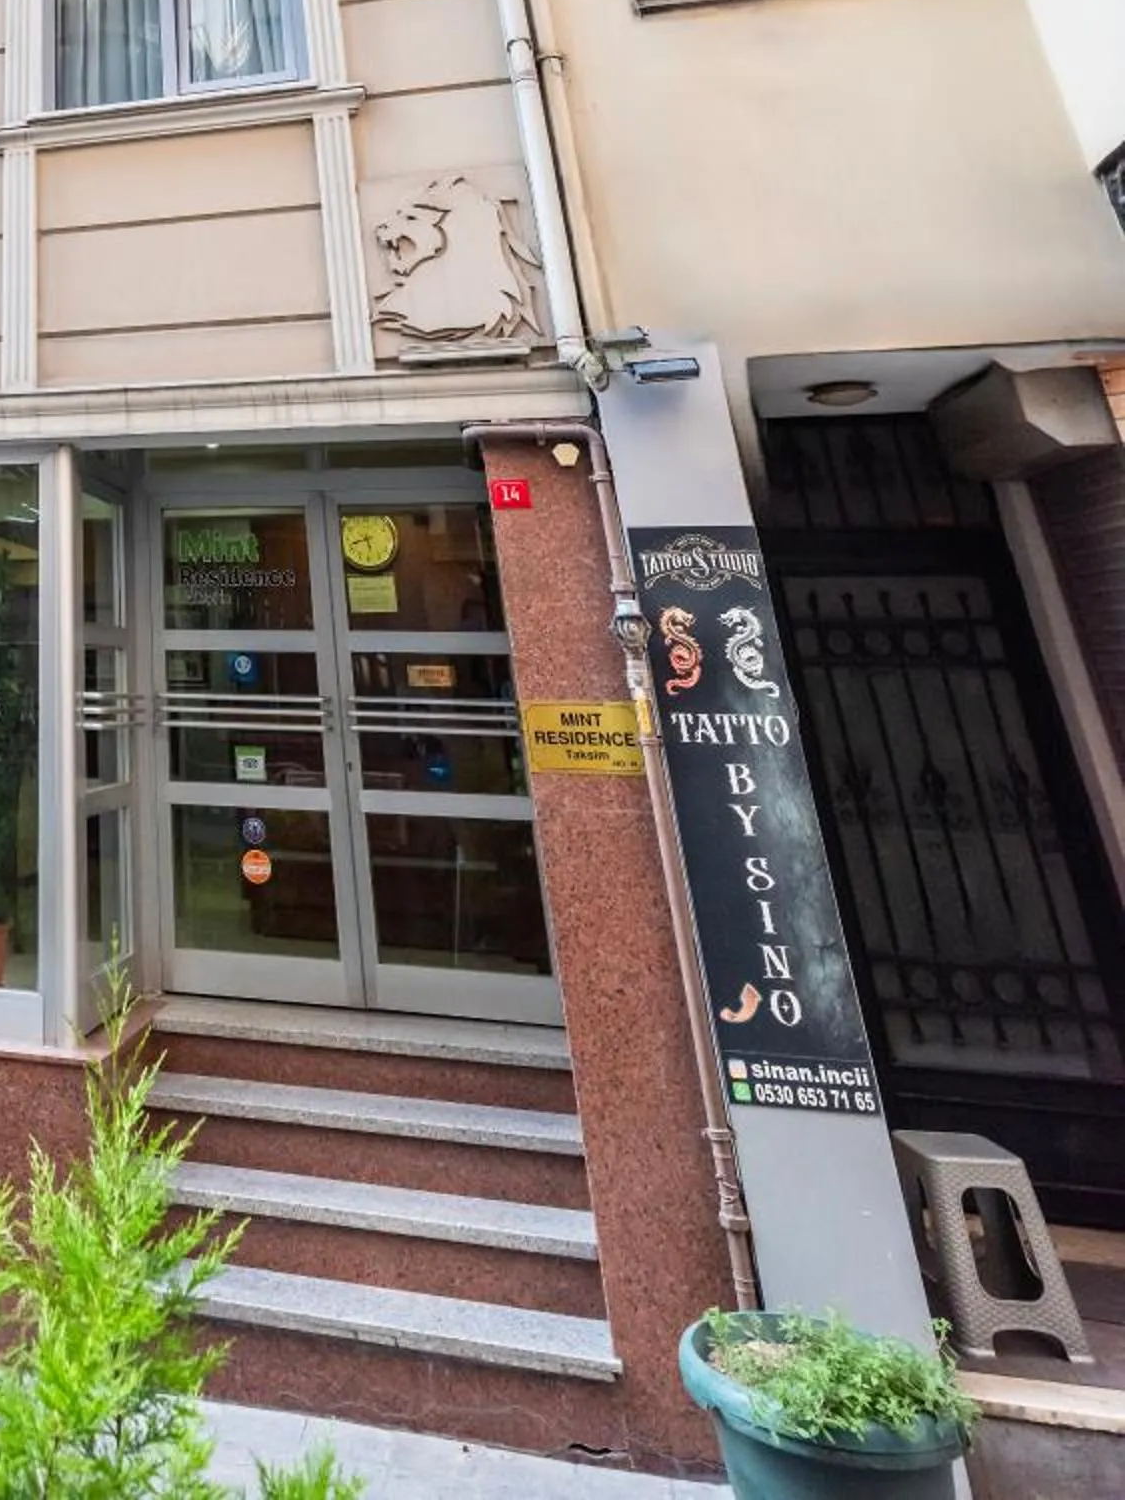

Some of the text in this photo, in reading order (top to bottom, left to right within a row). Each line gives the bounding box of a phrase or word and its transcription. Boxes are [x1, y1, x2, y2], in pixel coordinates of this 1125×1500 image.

[500, 485, 521, 501] 14
[560, 712, 602, 727] MINT
[670, 712, 791, 748] TATTO
[534, 730, 636, 748] RESIDENCE
[565, 749, 610, 761] Taksim
[754, 1083, 876, 1112] 0530 653 71 65
